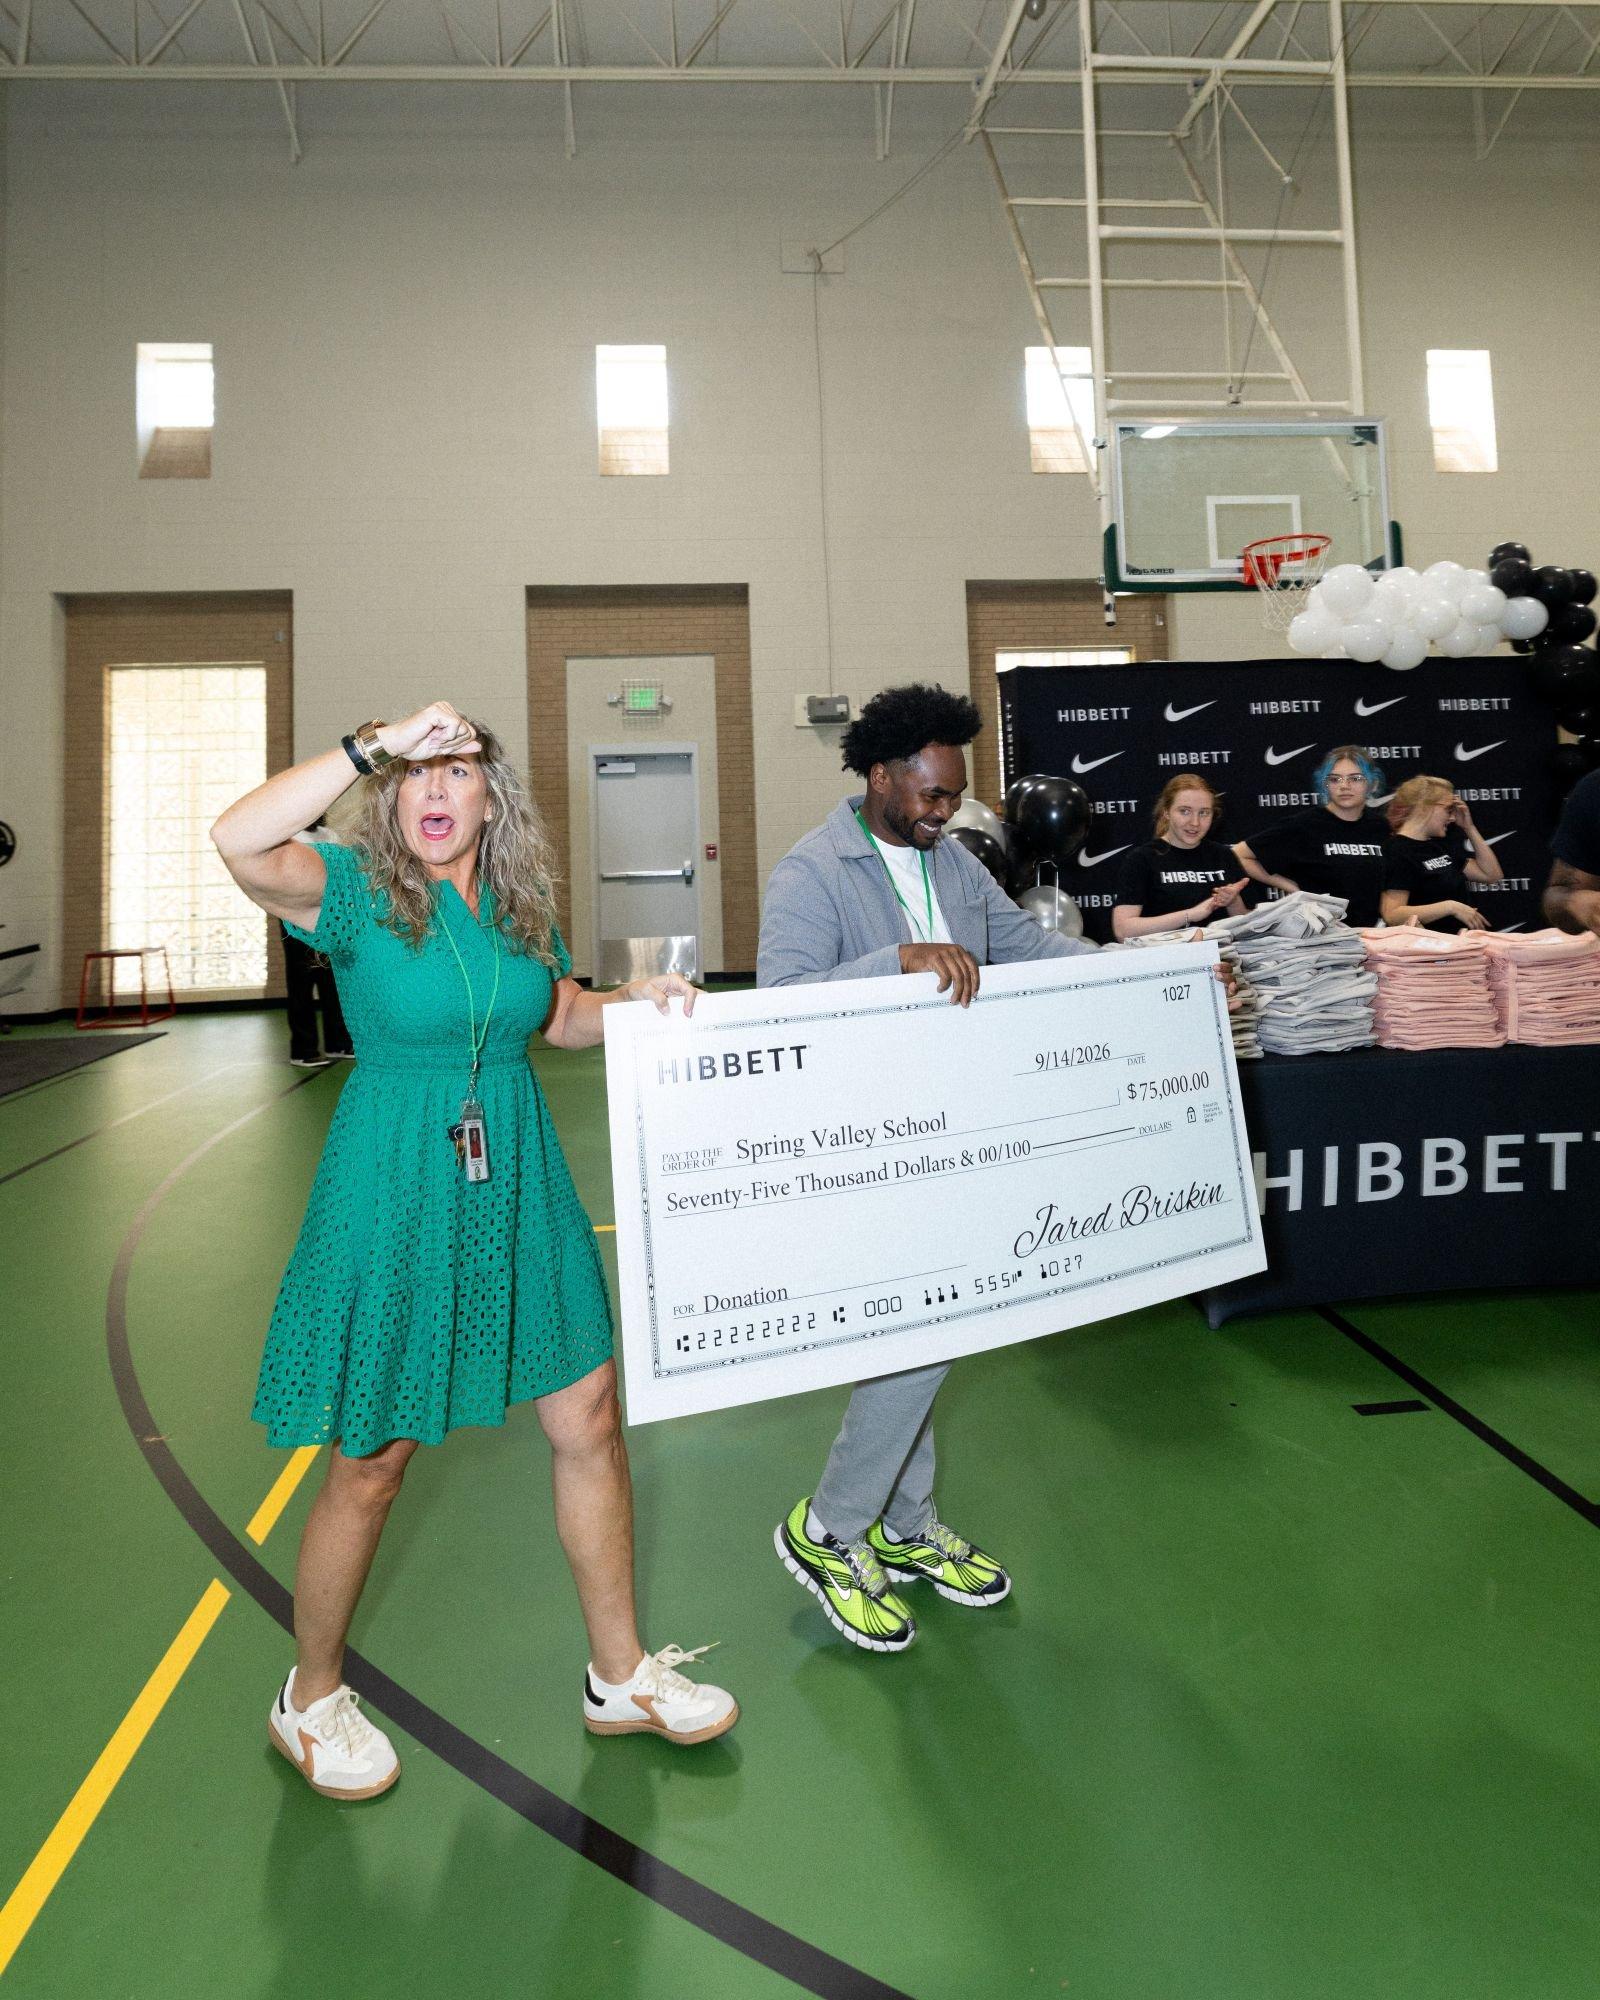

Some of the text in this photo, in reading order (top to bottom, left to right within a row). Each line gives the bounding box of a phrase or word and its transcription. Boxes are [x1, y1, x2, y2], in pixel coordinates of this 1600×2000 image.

[1250, 700, 1321, 715] HIBBETT
[1438, 698, 1511, 711] HIBBETT
[1057, 707, 1130, 722] HIBBETT
[1158, 751, 1231, 766] HIBBETT
[1361, 746, 1422, 759] BBETT
[1323, 843, 1383, 857] HIBBETT
[1160, 870, 1225, 883] HIBBETT
[1071, 893, 1118, 908] HIBB
[1162, 984, 1191, 1002] 1027
[658, 1044, 807, 1085] HIBBETT
[1035, 1043, 1111, 1071] 9/14/2026
[1127, 1055, 1147, 1067] DATE
[1127, 1070, 1210, 1102] $75,000.00
[1139, 1121, 1172, 1135] DOLLARS
[736, 1112, 947, 1163] Spring Valley School
[662, 1147, 723, 1163] PAY TO THE
[662, 1157, 718, 1172] ORDER OF
[667, 1140, 1031, 1212] Seventy-Five Thousand Dollars & 00/100
[1252, 1131, 1600, 1216] HIBBET
[1013, 1180, 1225, 1259] Jared Briskin
[864, 1296, 902, 1317] 000
[925, 1284, 959, 1306] 111
[1040, 1254, 1083, 1279] 1027
[673, 1286, 789, 1316] FOR Donation
